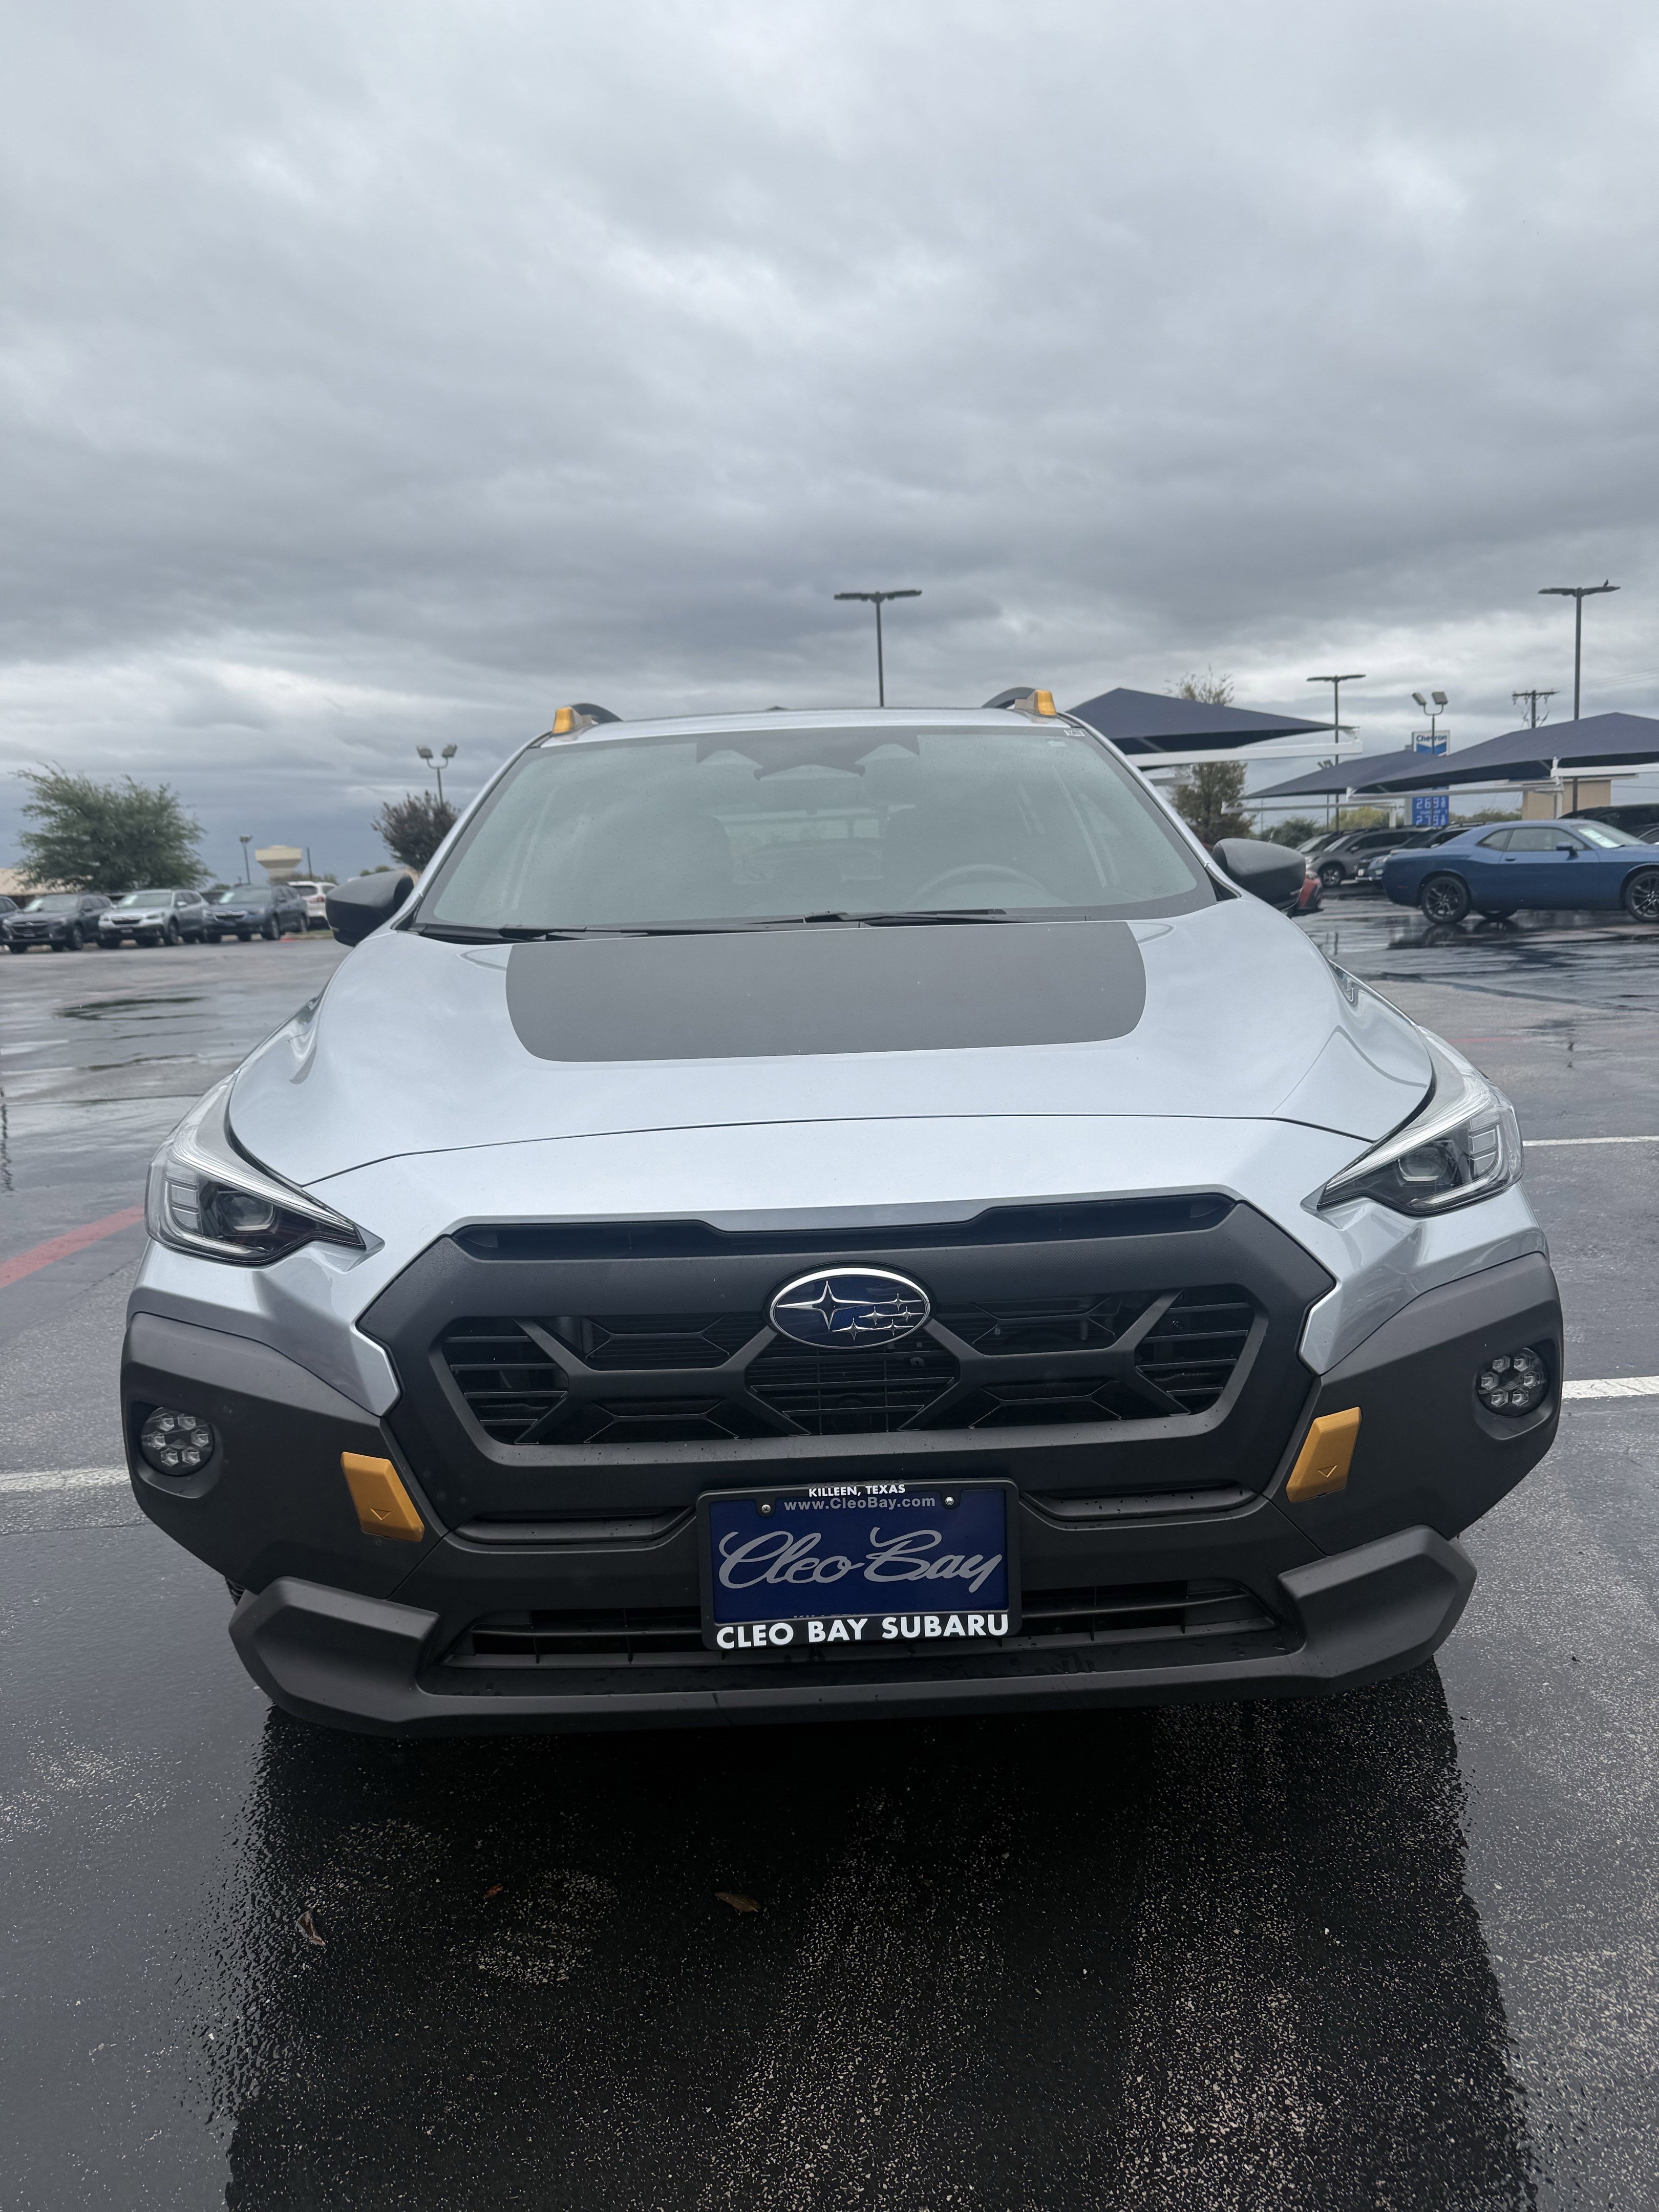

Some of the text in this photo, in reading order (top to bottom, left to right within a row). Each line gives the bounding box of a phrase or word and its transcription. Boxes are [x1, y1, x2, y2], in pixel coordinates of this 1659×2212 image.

[809, 1484, 906, 1497] KILLEEN, TEXAS
[783, 1497, 936, 1511] www.CleoBay.com
[719, 1527, 1003, 1593] Cleo Bay
[716, 1614, 1009, 1649] CLEO BAY SUBARU
